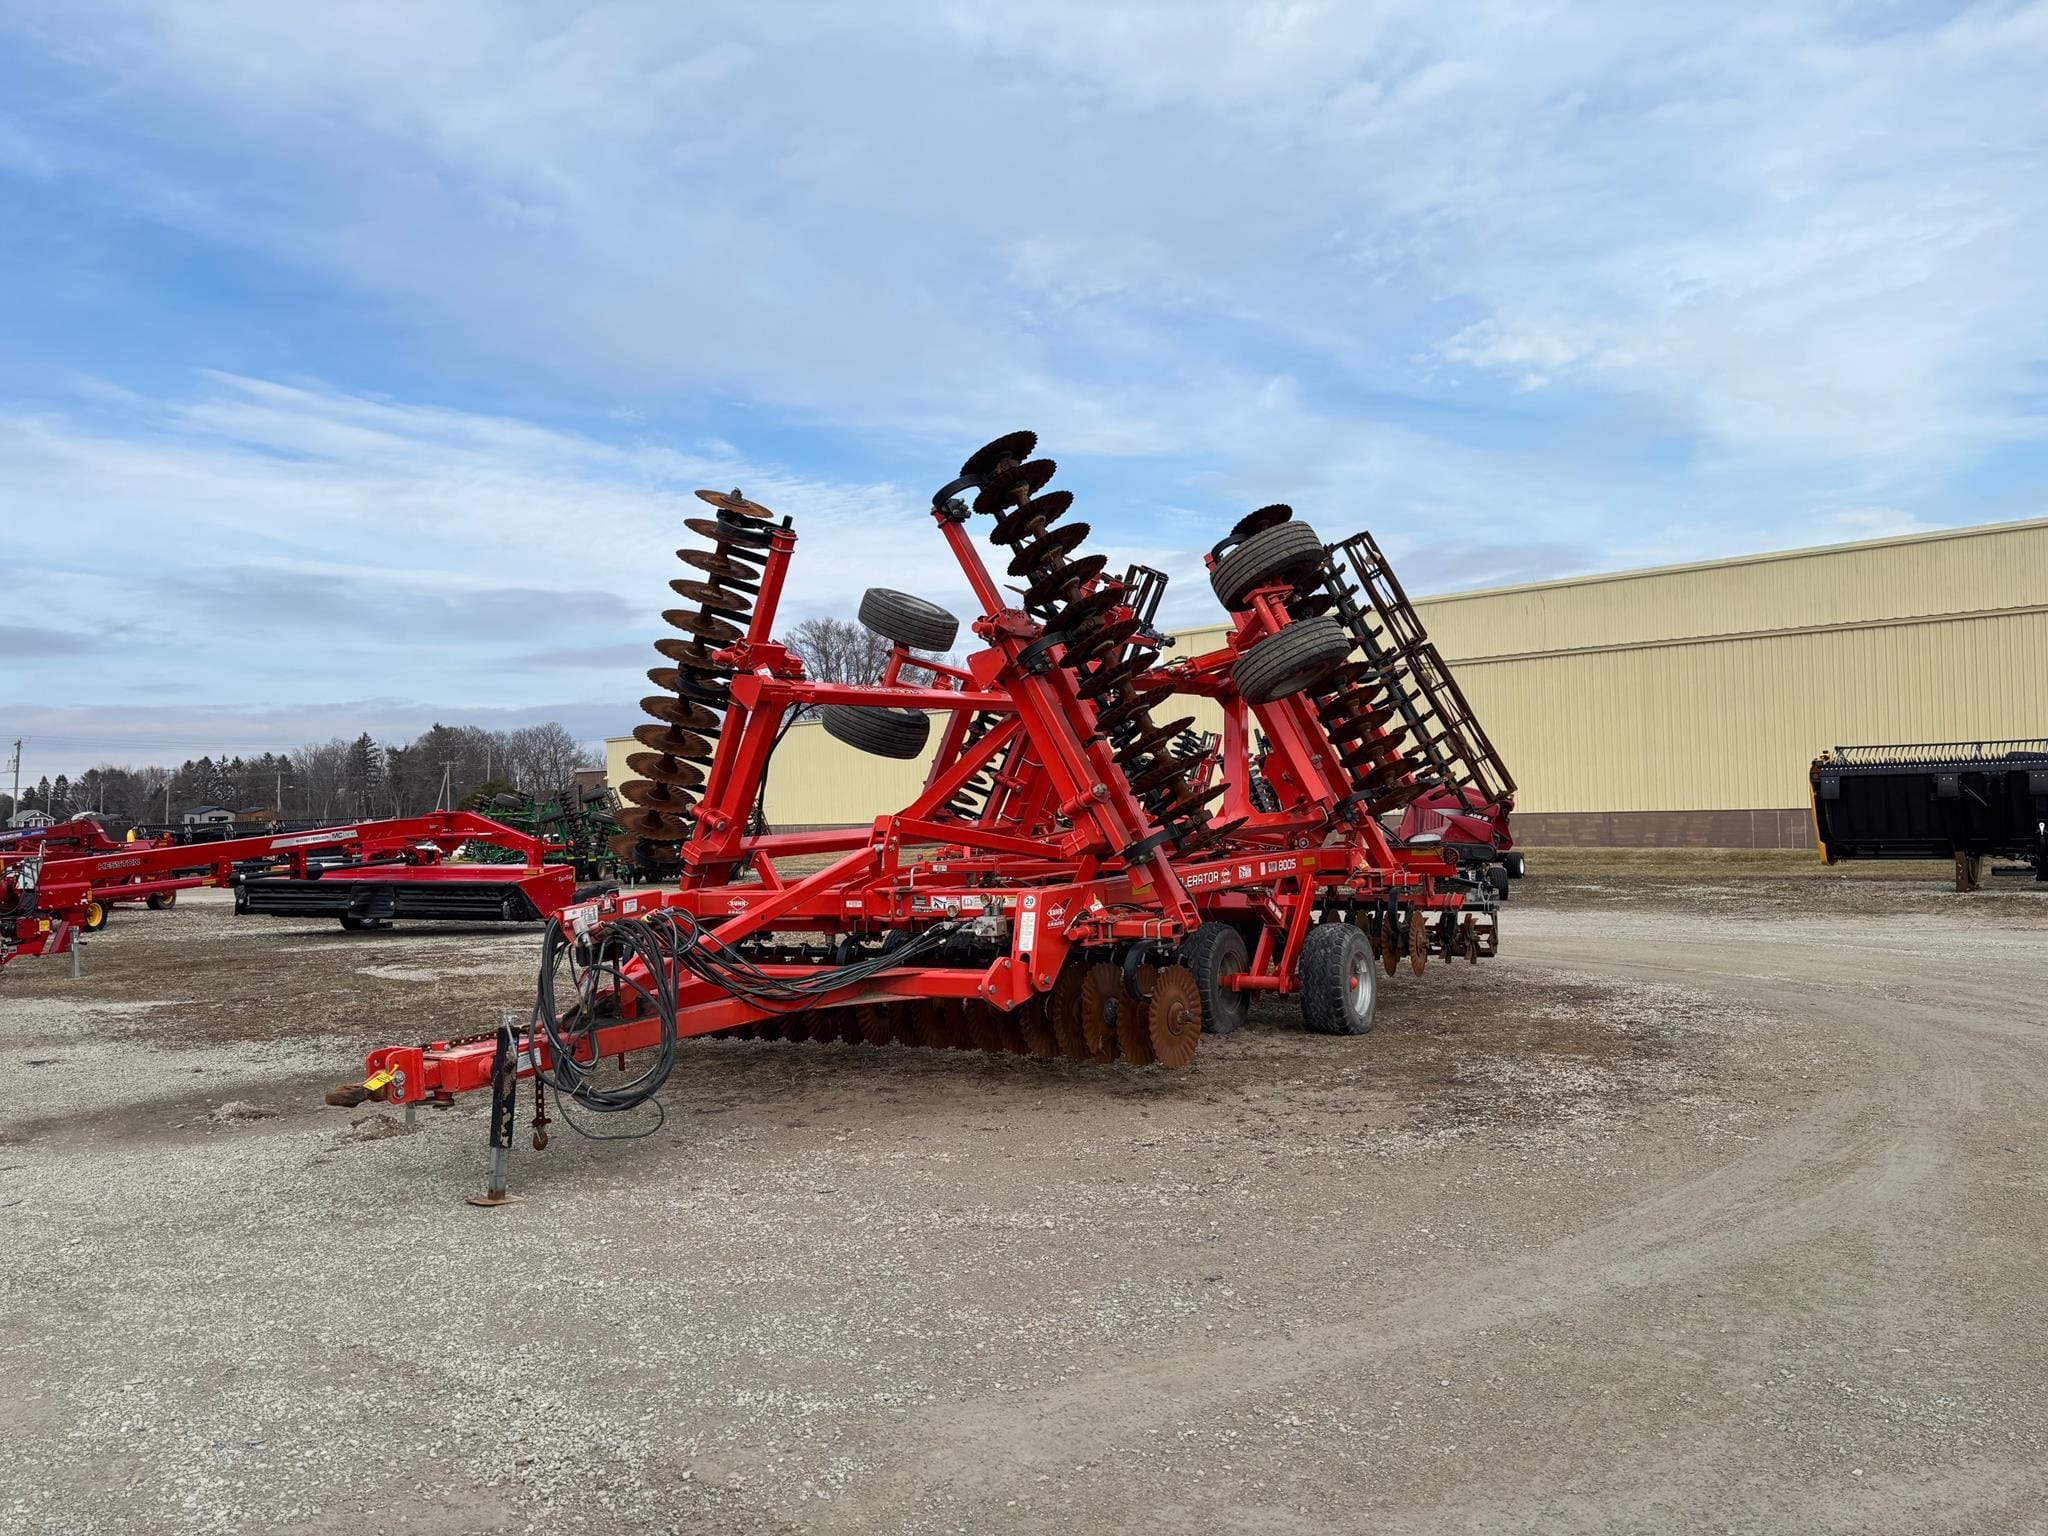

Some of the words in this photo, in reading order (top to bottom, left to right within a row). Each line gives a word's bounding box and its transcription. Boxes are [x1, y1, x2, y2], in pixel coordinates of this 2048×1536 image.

[97, 858, 141, 871] HESSTON
[1278, 858, 1297, 872] 8005
[1178, 871, 1219, 888] LERATOR
[1025, 897, 1034, 905] 20
